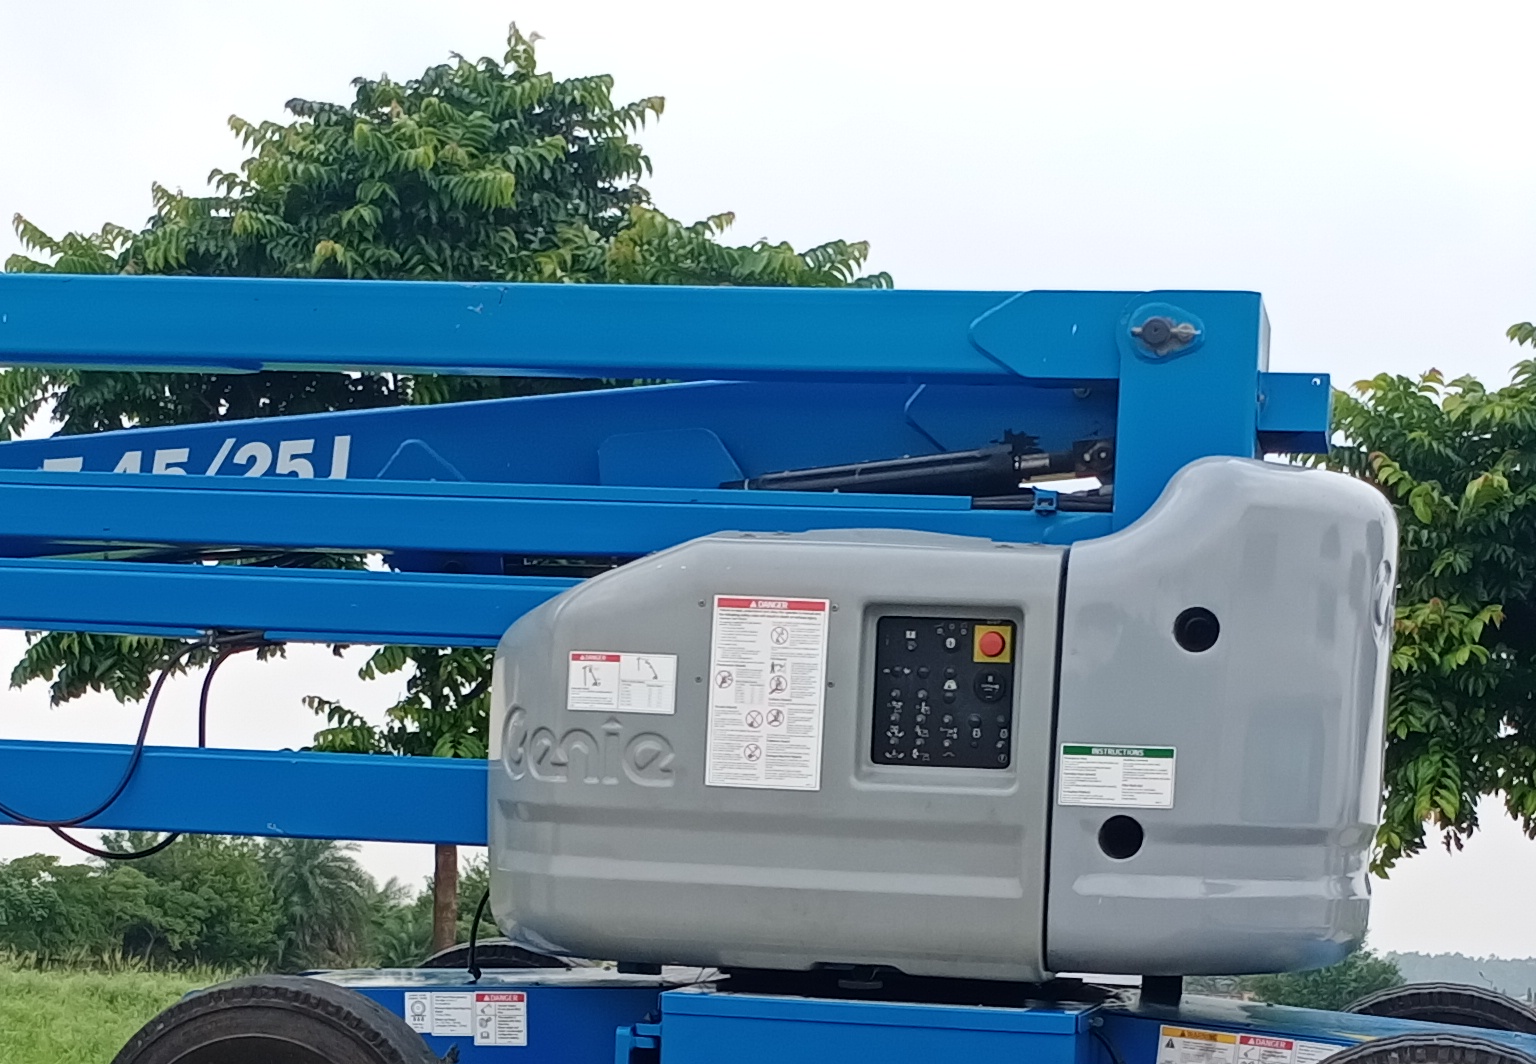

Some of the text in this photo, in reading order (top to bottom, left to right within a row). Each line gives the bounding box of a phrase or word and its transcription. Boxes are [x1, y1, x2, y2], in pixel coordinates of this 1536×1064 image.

[757, 600, 789, 609] DANGER
[501, 702, 676, 787] Genie
[1091, 747, 1144, 756] INSTRUCTIONS
[490, 994, 518, 1002] DANGER
[1255, 1038, 1287, 1049] DANGER
